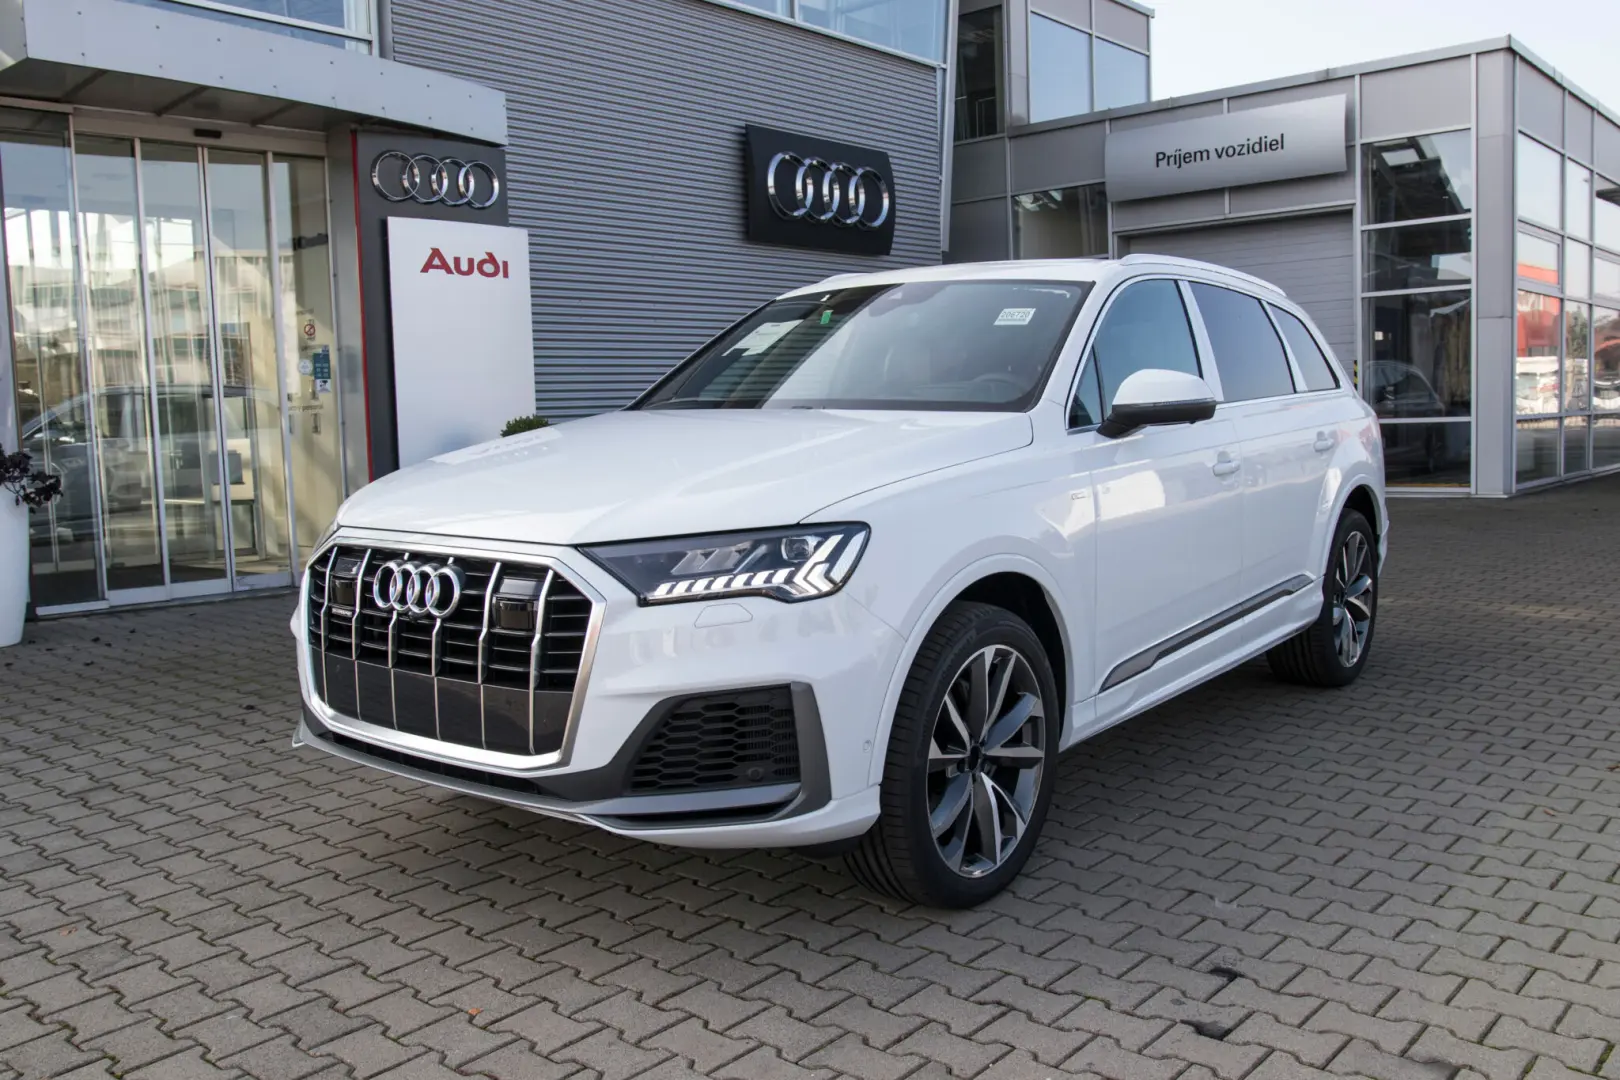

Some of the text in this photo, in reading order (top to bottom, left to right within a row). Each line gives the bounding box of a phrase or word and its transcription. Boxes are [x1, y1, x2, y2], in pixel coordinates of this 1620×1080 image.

[1155, 133, 1285, 169] Príjem vozidiel
[420, 247, 509, 279] Audi
